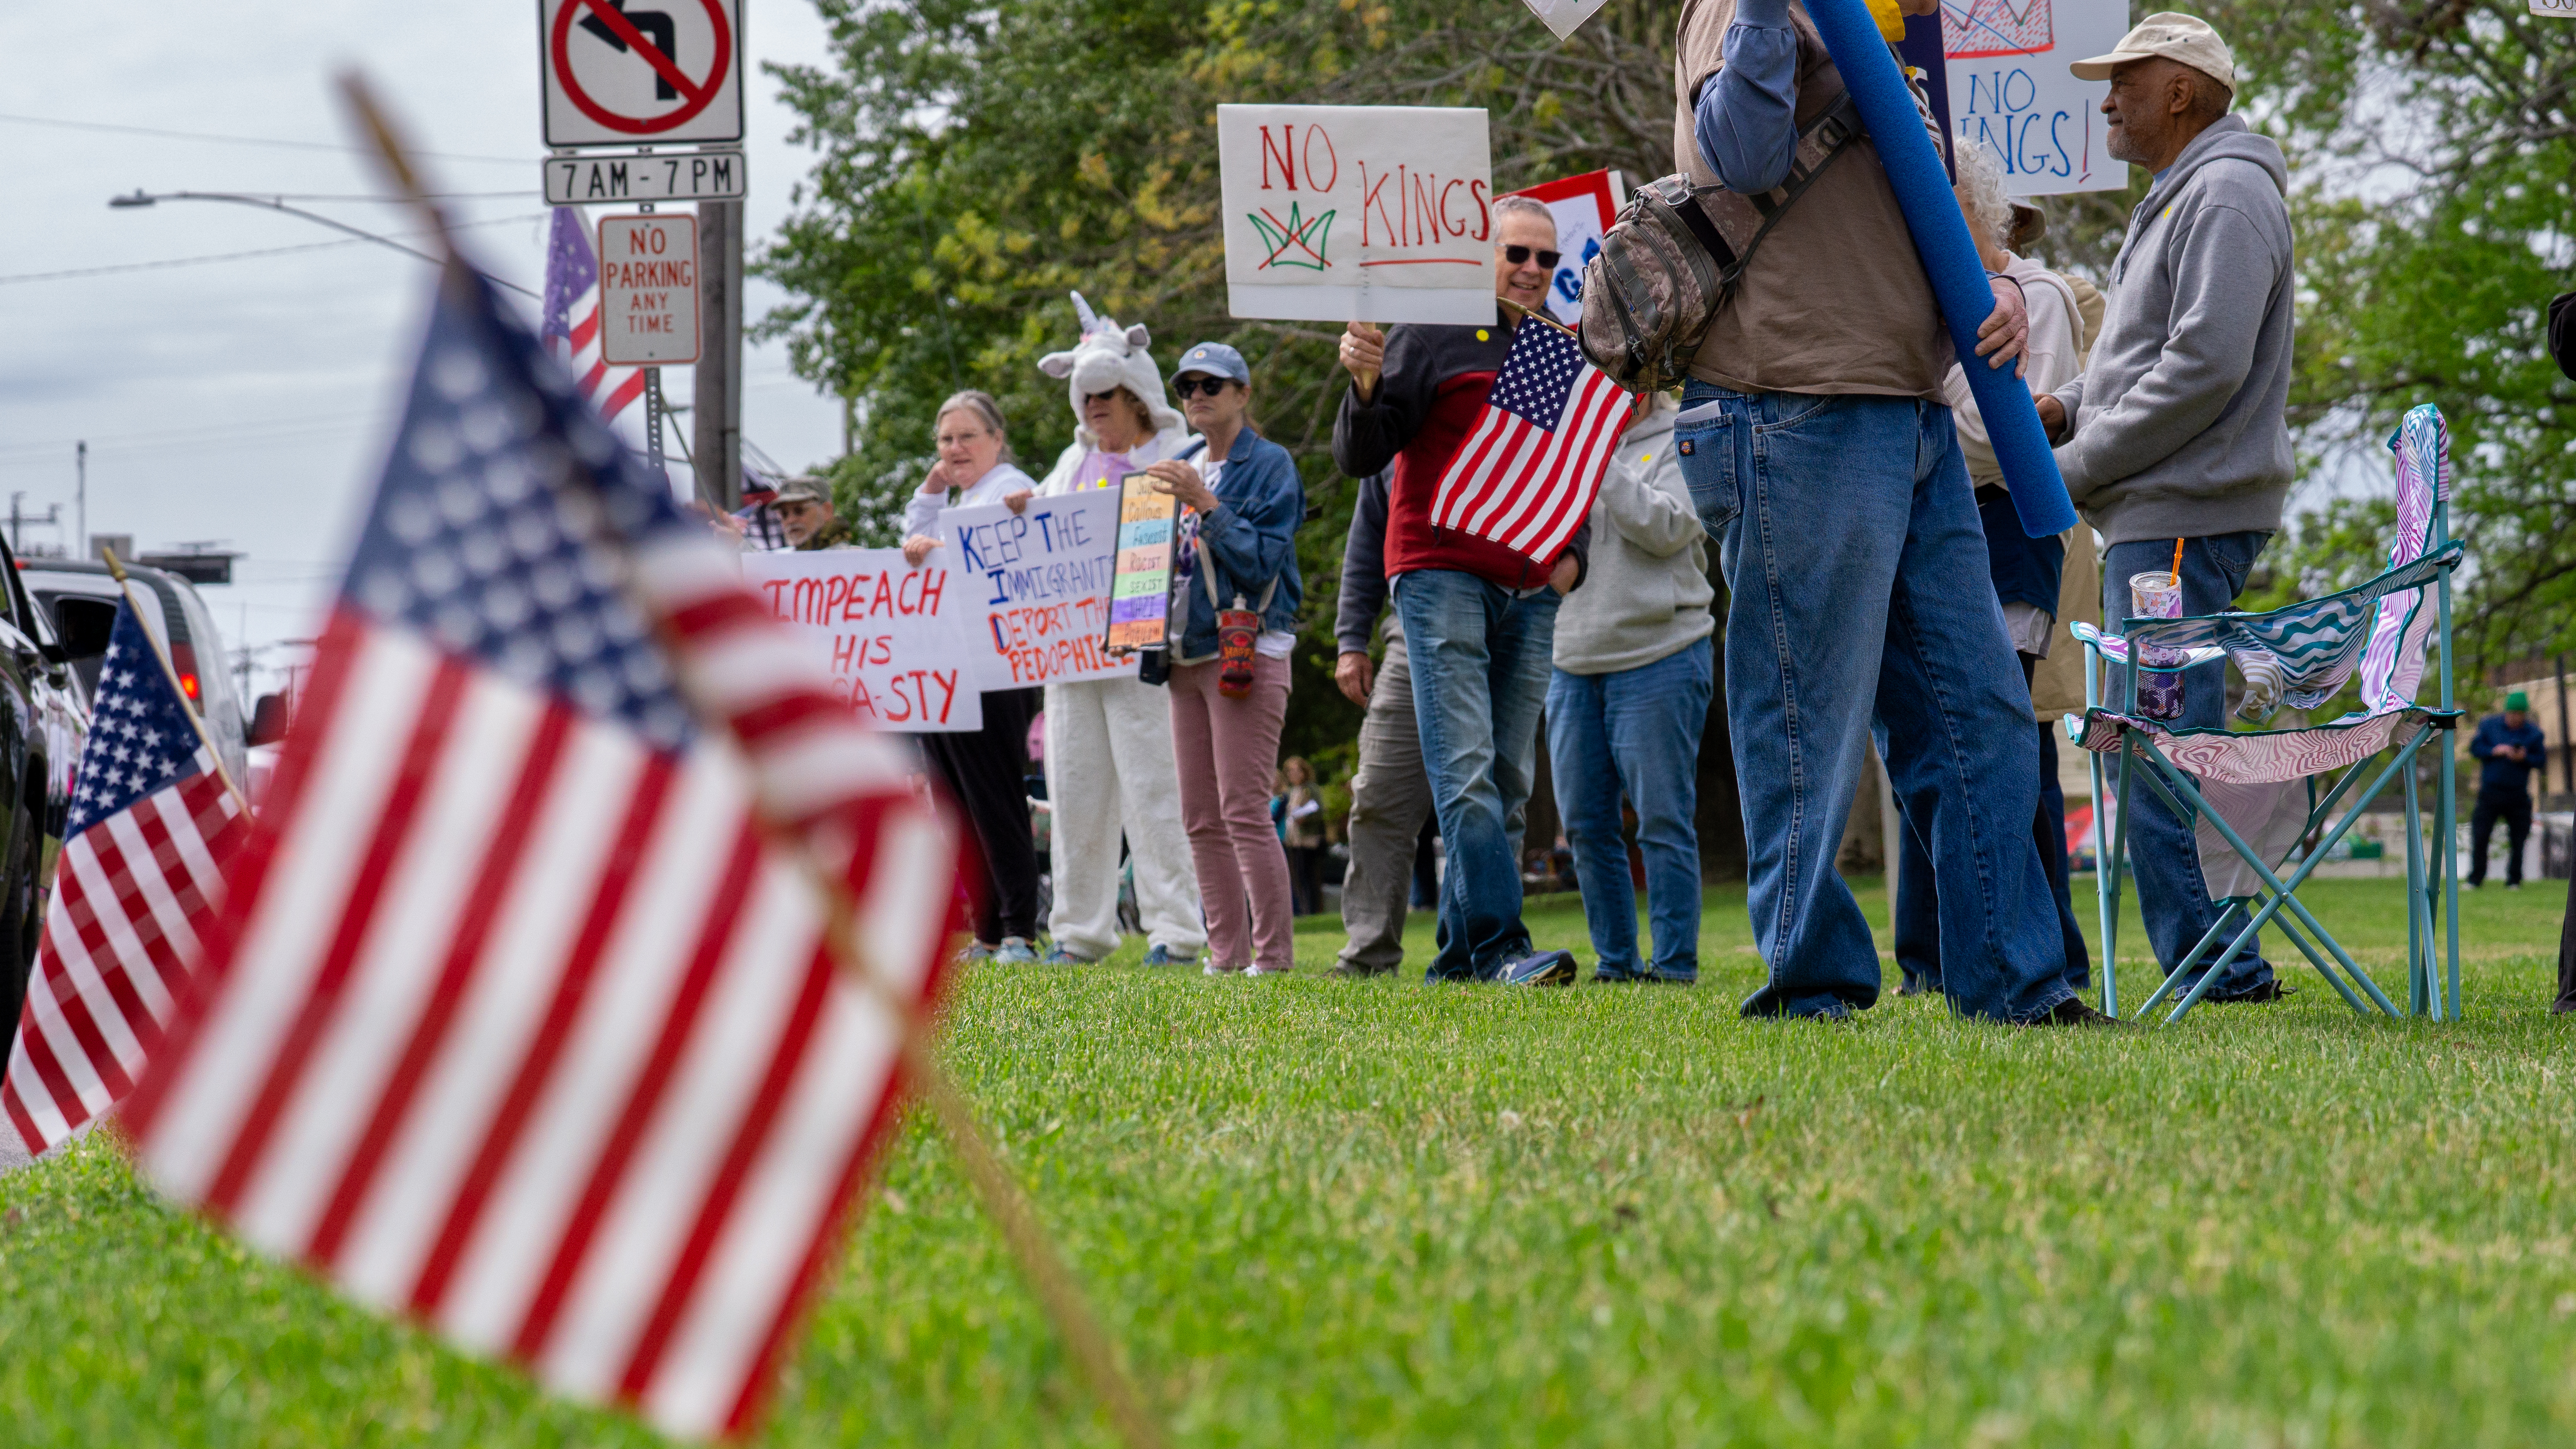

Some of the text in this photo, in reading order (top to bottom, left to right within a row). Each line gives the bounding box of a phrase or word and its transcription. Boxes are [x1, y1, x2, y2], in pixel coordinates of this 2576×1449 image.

[1968, 68, 2035, 114] NO
[562, 164, 577, 199] 7
[588, 161, 629, 198] AM
[664, 160, 680, 194] 7
[693, 158, 731, 194] PM
[1259, 123, 1337, 193] NO
[1358, 160, 1490, 247] KINGS
[629, 227, 666, 255] NO
[606, 261, 692, 289] PARKING
[631, 293, 669, 310] ANY
[628, 313, 675, 334] TIME
[957, 509, 1093, 573] KEEP THE
[762, 567, 947, 627] IMPEACH
[988, 602, 1072, 656] DEPORT
[830, 634, 892, 674] HIS
